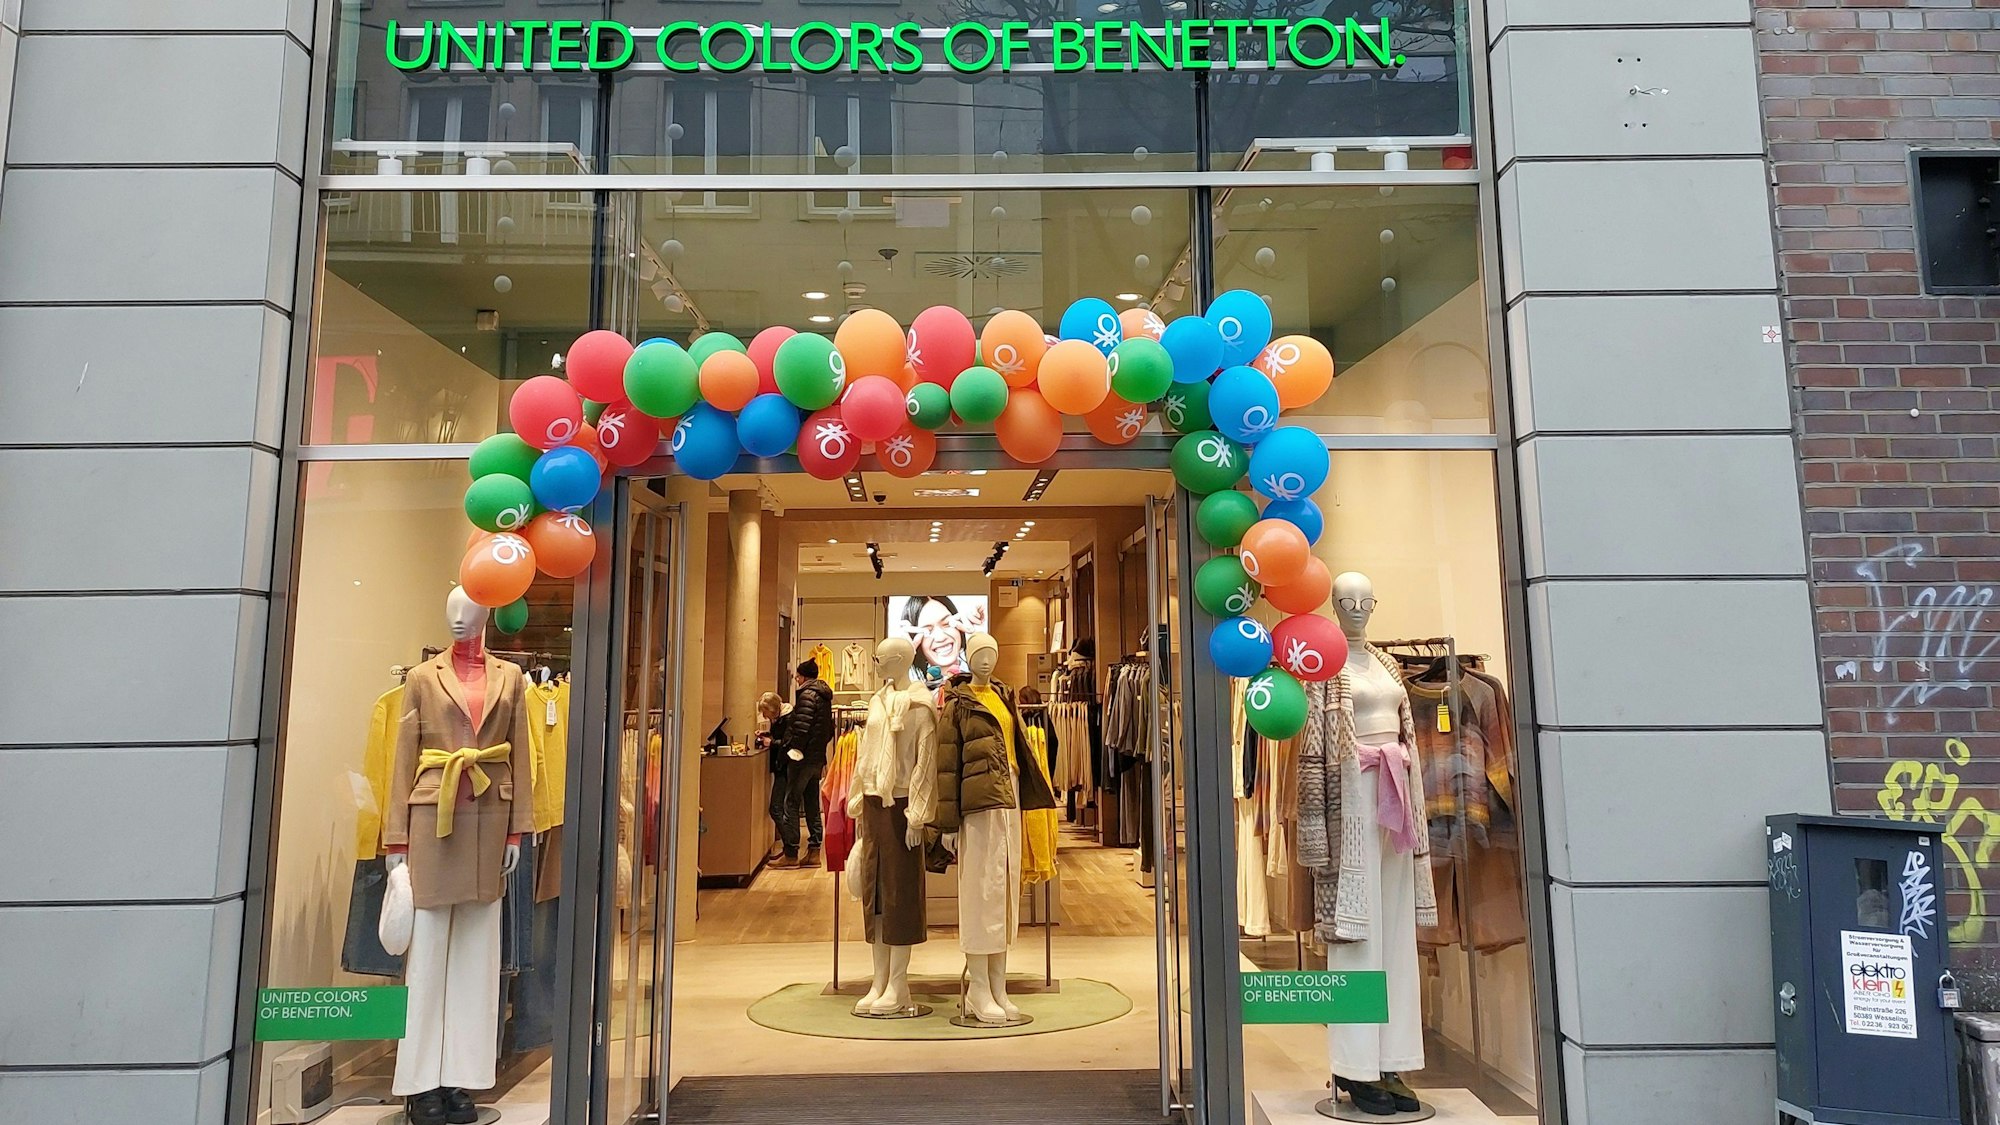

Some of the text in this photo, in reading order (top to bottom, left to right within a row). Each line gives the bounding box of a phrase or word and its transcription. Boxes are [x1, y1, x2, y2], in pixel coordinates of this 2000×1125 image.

[385, 16, 1408, 72] UNITED COLORS OF BENETTON.
[1850, 961, 1905, 979] elektro
[1243, 974, 1347, 987] UNITED COLORS
[1853, 975, 1890, 992] klein
[262, 990, 368, 1004] UNITED COLORS
[1243, 989, 1335, 1003] OF BENETTON.
[260, 1006, 353, 1019] OF BENETTON.
[1854, 1005, 1893, 1013] Rheinstraße
[1874, 1014, 1908, 1023] Wesseling
